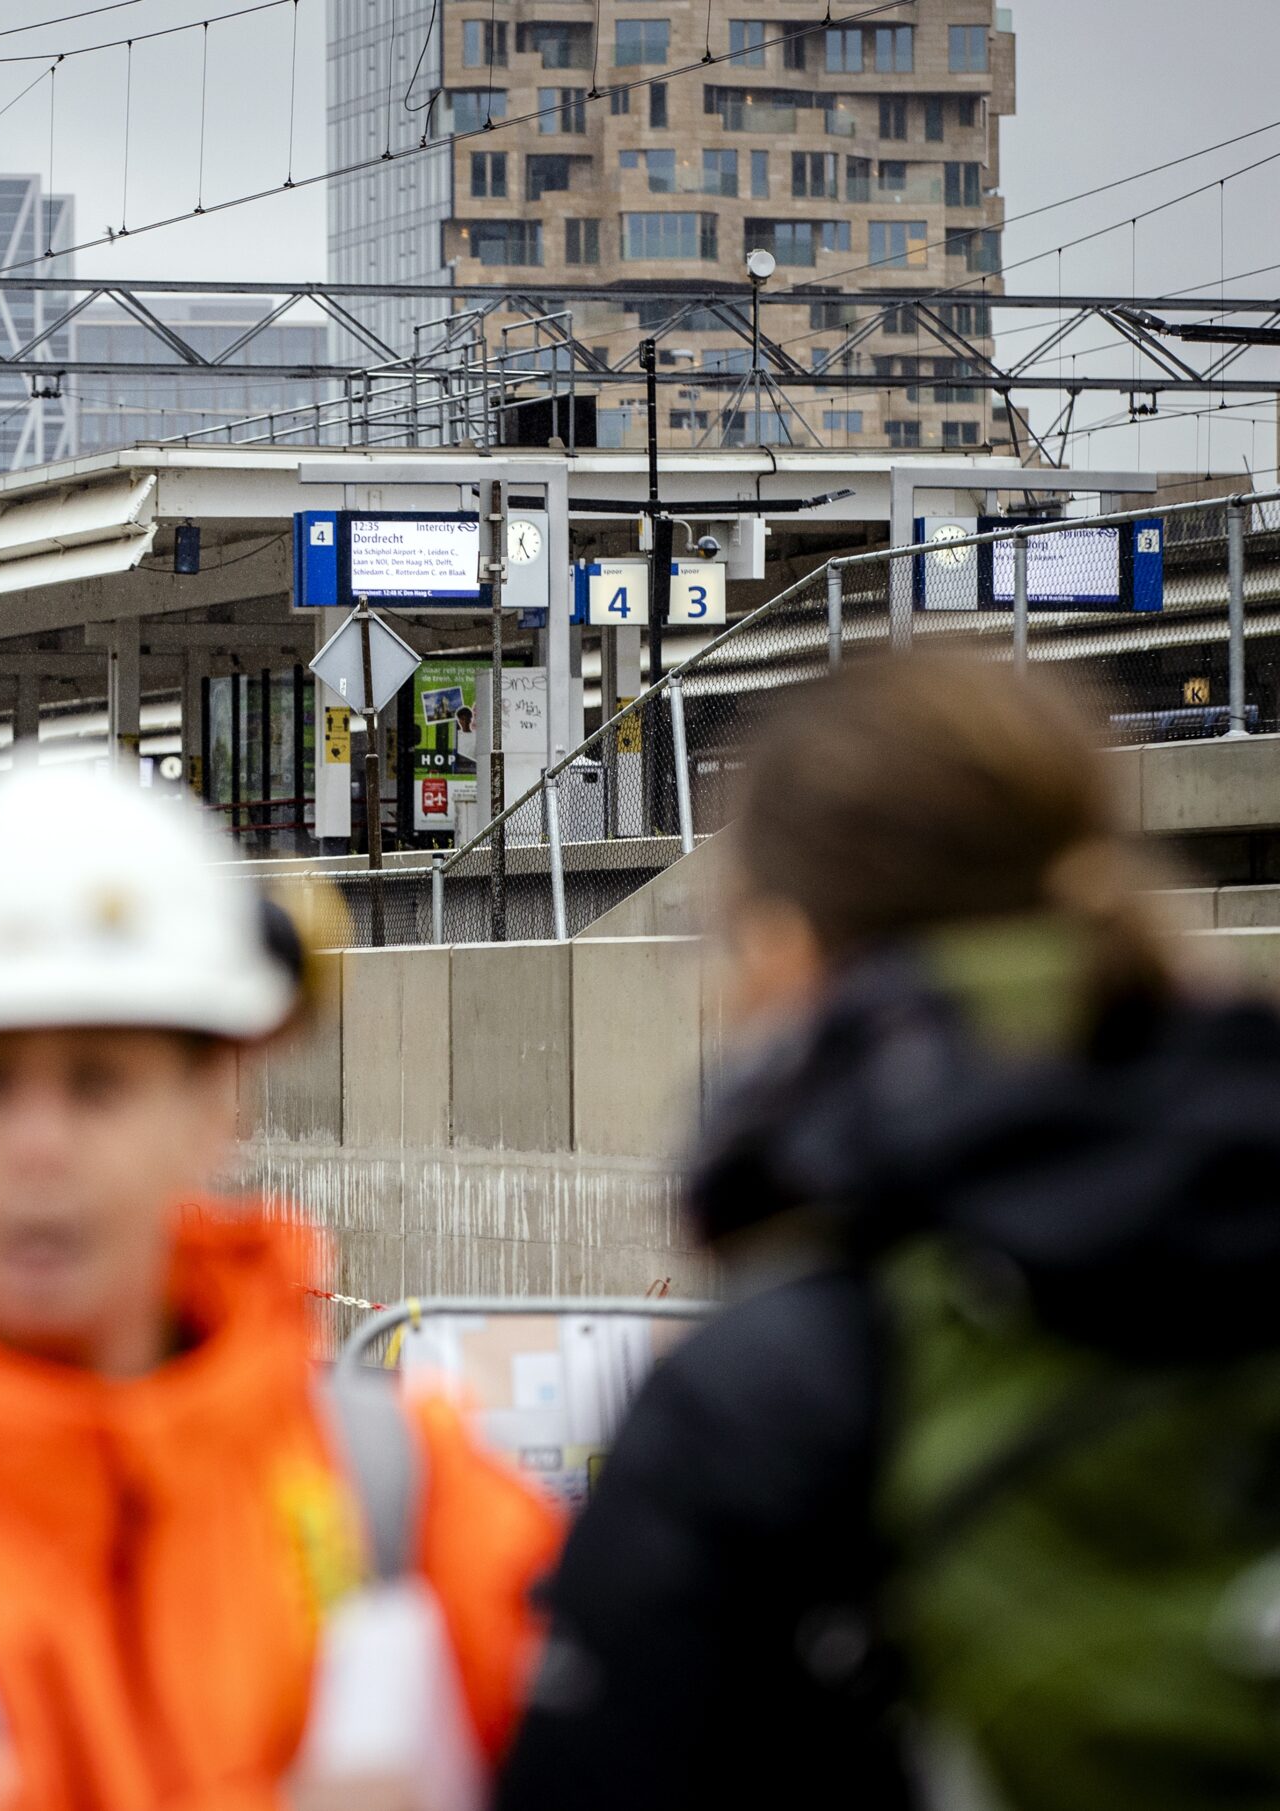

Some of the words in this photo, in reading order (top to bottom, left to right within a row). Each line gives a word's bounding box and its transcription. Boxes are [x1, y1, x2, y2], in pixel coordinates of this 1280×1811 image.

[354, 522, 379, 531] 12:35
[417, 522, 455, 533] Intercity
[316, 530, 326, 543] 4
[353, 533, 403, 544] Dordrecht
[1145, 537, 1153, 550] 3
[406, 559, 422, 567] Haag
[608, 587, 631, 618] 4
[688, 586, 707, 618] 3
[1191, 687, 1202, 702] K
[421, 754, 456, 766] HOP
